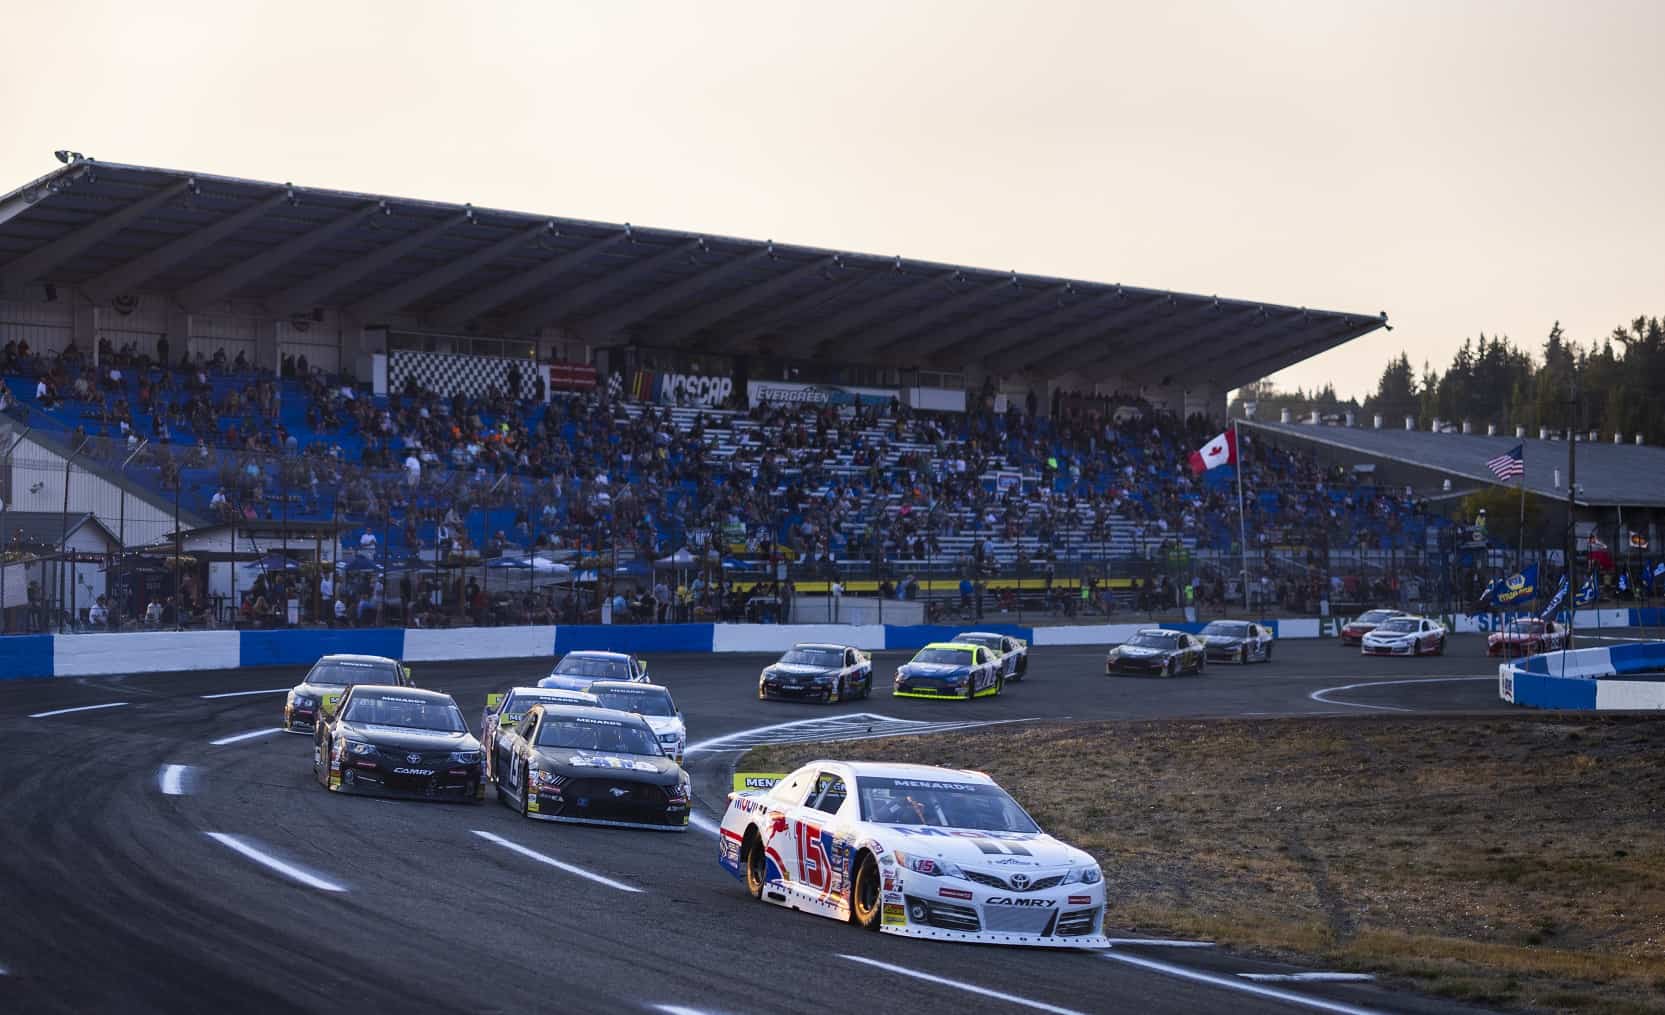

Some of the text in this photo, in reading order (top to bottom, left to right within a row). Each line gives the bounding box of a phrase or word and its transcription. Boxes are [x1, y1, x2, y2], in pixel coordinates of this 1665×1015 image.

[576, 717, 623, 726] MENARDS
[394, 767, 435, 777] CAMRY
[893, 779, 977, 793] MENARDS
[795, 820, 833, 894] 15
[916, 860, 936, 873] 15
[986, 896, 1058, 908] CAMRY
